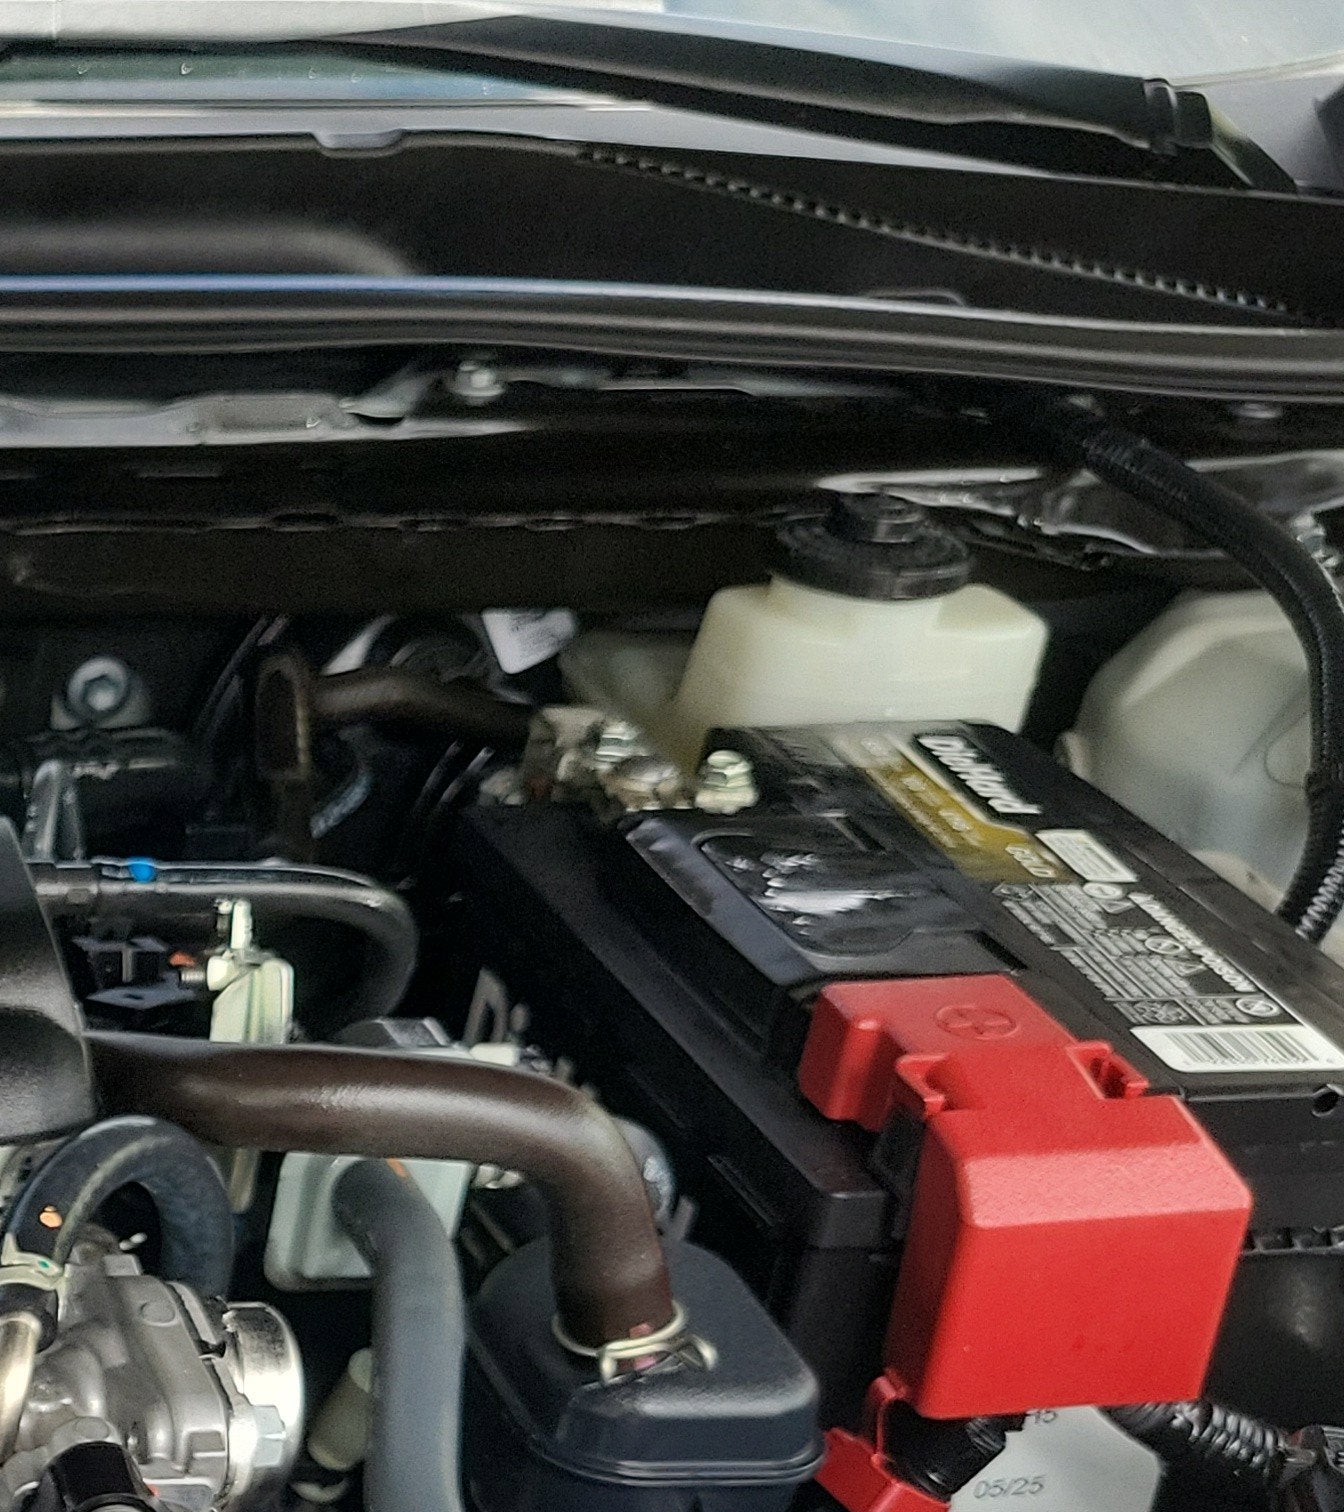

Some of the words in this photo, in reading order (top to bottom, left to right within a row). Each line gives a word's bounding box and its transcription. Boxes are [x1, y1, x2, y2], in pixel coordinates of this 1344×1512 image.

[917, 735, 1043, 814] DieHard
[1005, 844, 1057, 878] GOLD
[972, 1474, 1046, 1500] 05/25
